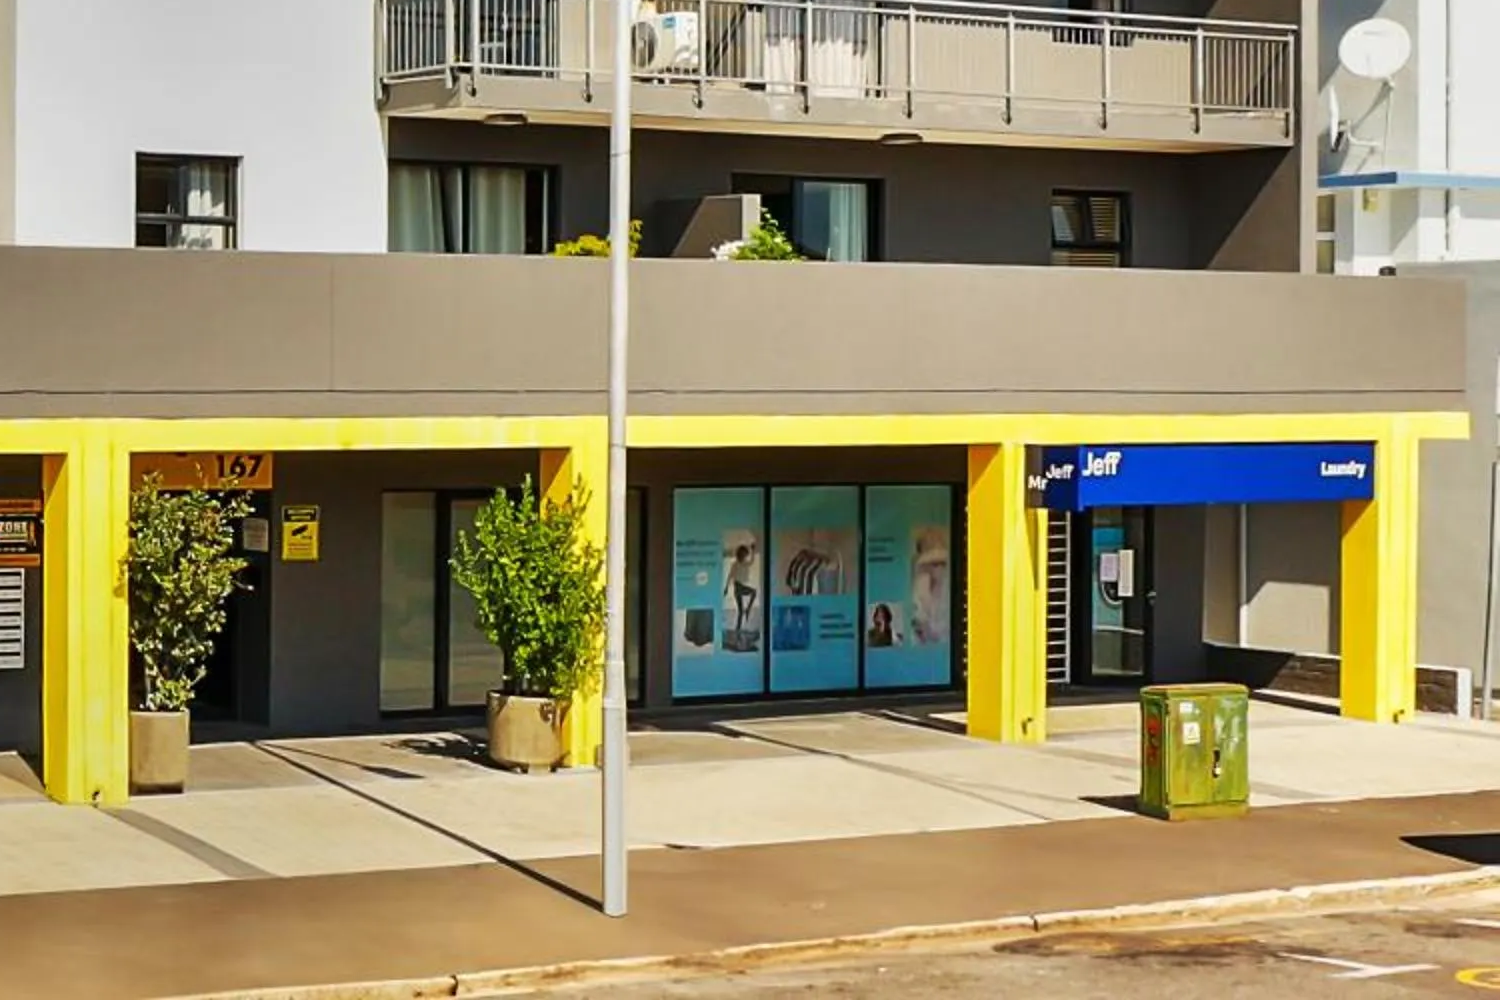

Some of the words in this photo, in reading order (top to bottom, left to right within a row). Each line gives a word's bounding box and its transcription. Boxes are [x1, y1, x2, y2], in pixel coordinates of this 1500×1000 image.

[216, 454, 264, 478] 167
[1028, 475, 1049, 491] Mr
[1045, 463, 1075, 479] Jeff
[1082, 451, 1122, 477] Jeff
